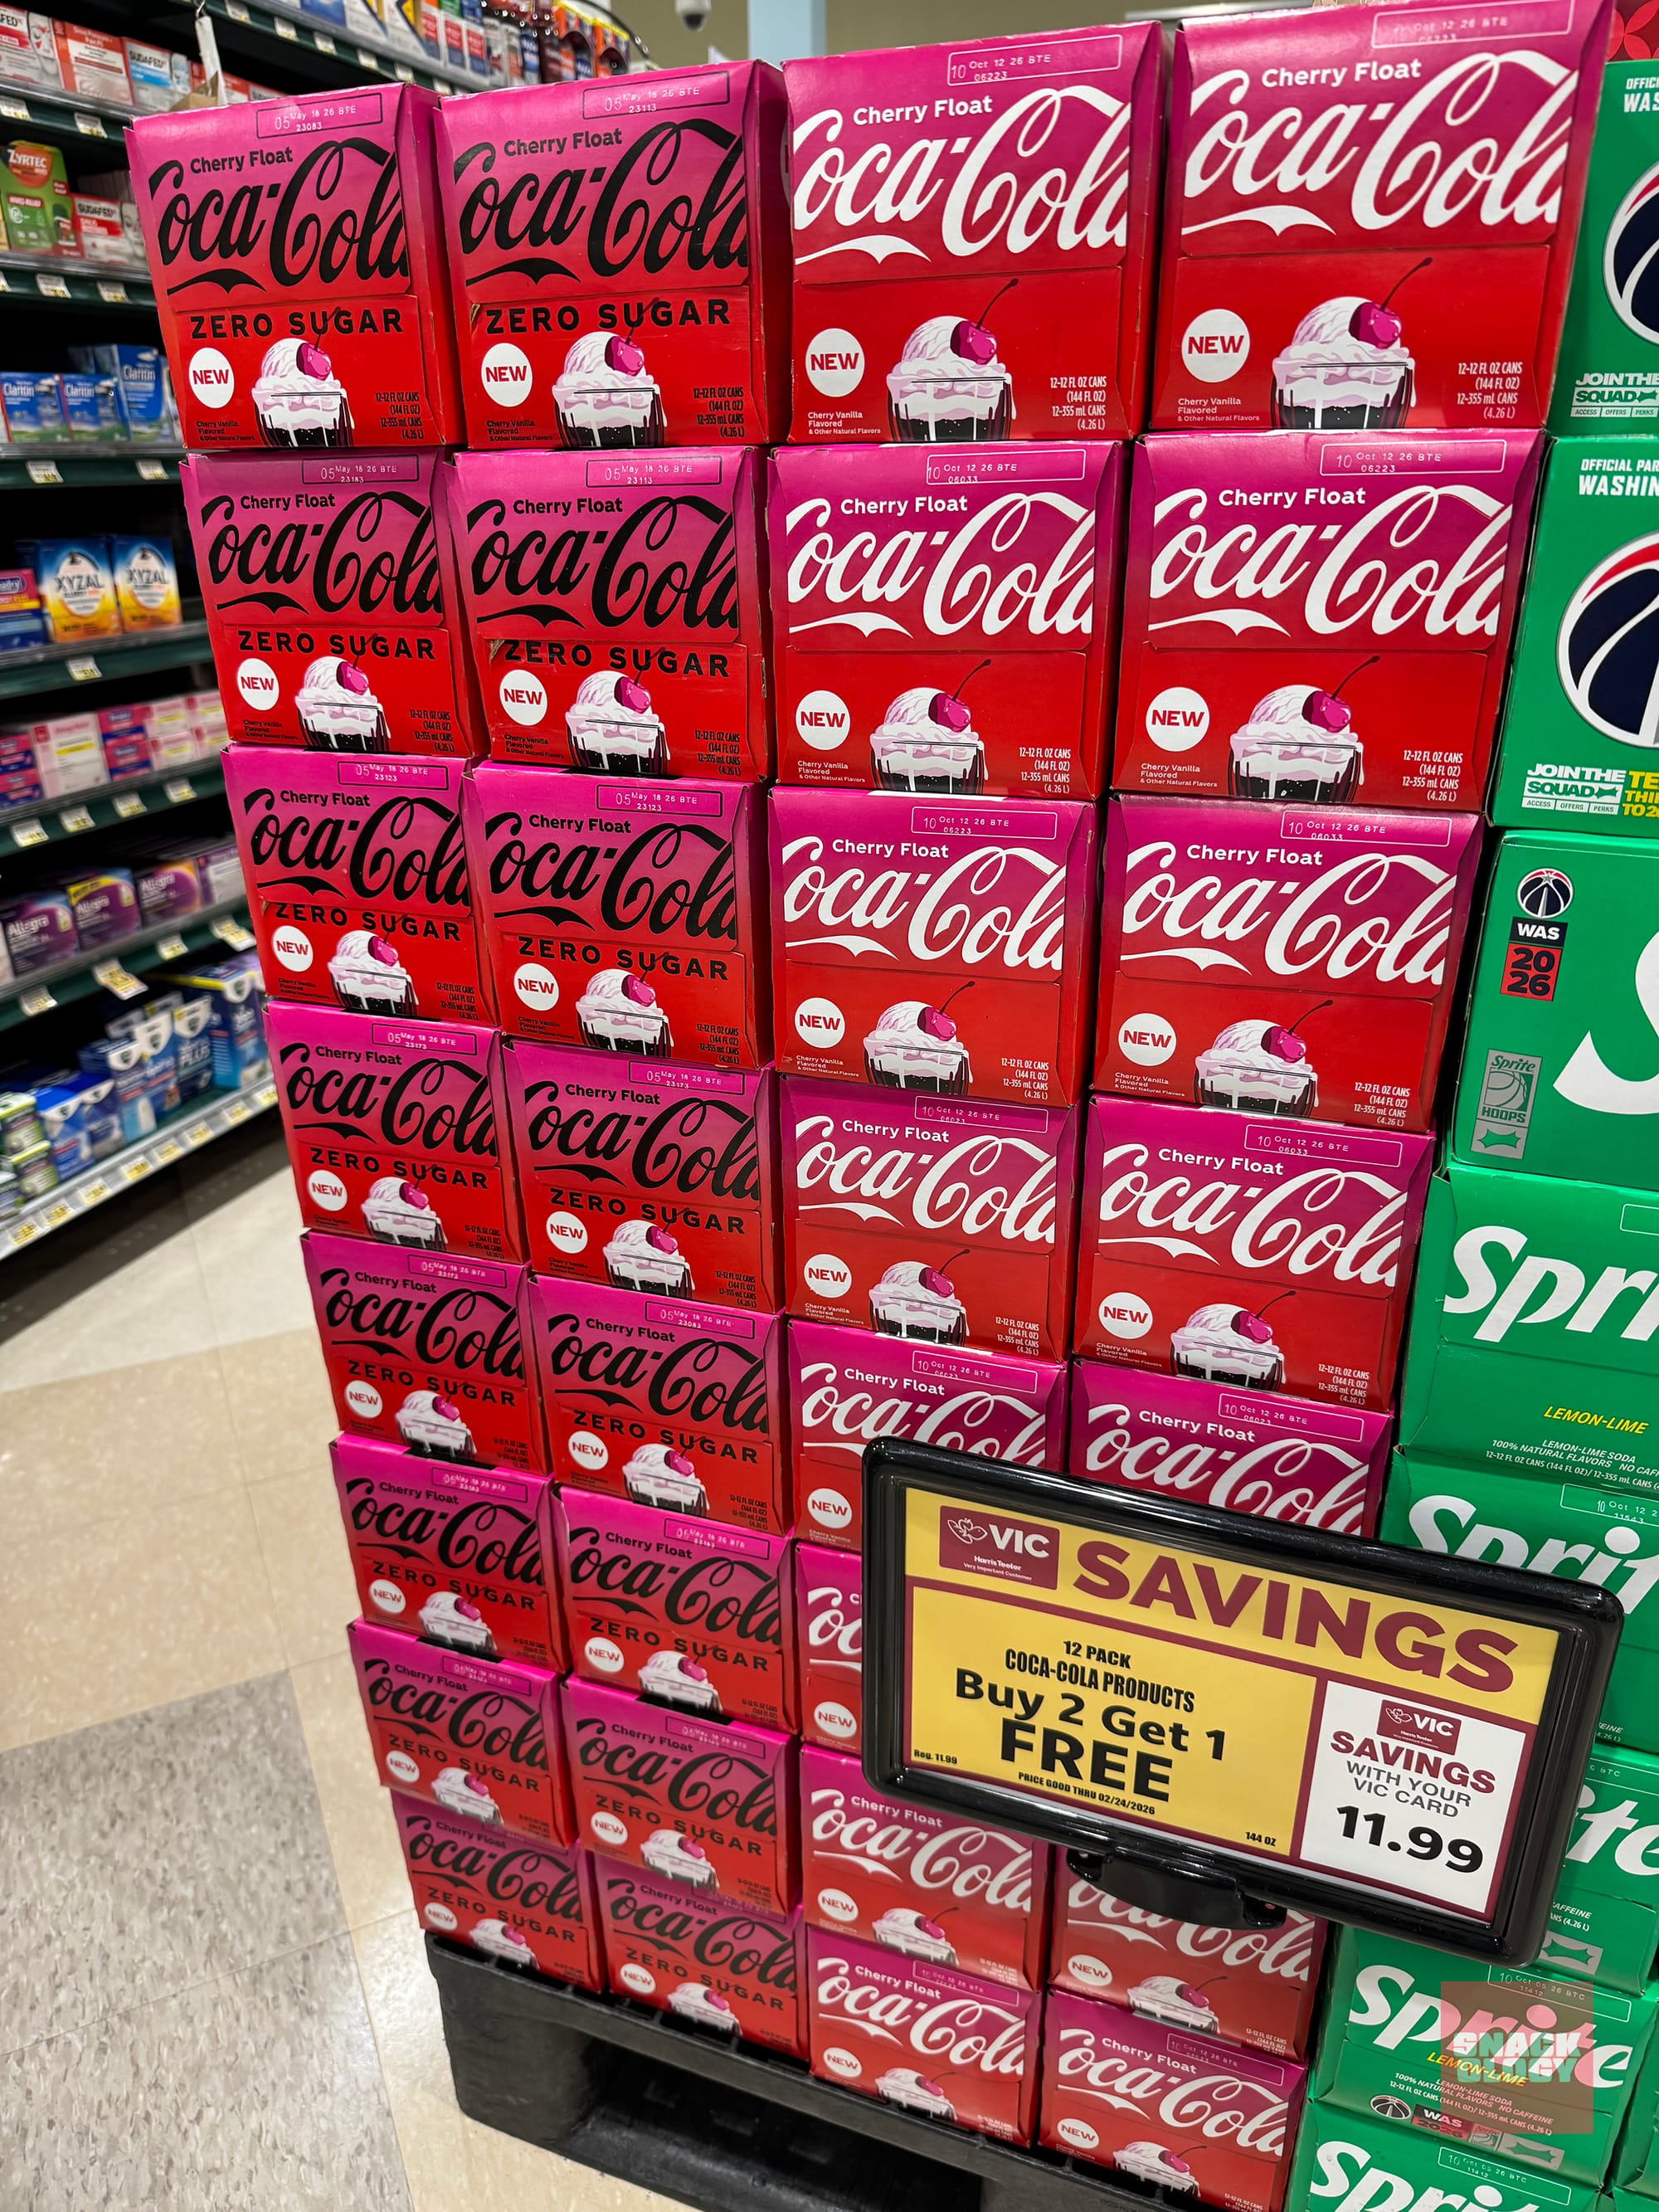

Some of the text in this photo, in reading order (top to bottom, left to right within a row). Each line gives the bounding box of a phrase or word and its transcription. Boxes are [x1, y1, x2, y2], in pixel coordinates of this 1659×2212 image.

[854, 96, 992, 125] Cherry Float
[8, 149, 47, 168] ZYRTEC
[191, 148, 293, 174] Cherry Float
[190, 309, 403, 339] ZERO SUGAR
[1188, 335, 1244, 354] NEW
[810, 353, 859, 371] NEW
[124, 366, 155, 380] Claritin
[192, 370, 229, 385] NEW
[485, 366, 527, 382] NEW
[1576, 373, 1623, 385] JOIN
[3, 384, 34, 397] Claritin
[65, 383, 94, 397] Claritin
[1050, 377, 1107, 388] 12-12 FL OZ CANS
[1067, 392, 1106, 402] (144 FL OZ)
[1575, 390, 1637, 402] SQUAD
[808, 412, 834, 420] Cherry
[1053, 406, 1106, 417] 12-355 mL CANS
[1078, 419, 1105, 430] (4.26 L)
[944, 464, 961, 472] Oct
[966, 464, 976, 472] 12
[981, 464, 994, 472] 26
[1581, 459, 1632, 471] OFFICIAL
[55, 575, 104, 591] XYZAL
[128, 570, 168, 583] XYZAL
[241, 676, 274, 690] NEW
[504, 689, 542, 705] NEW
[800, 711, 845, 728] NEW
[1151, 710, 1204, 727] NEW
[1527, 763, 1627, 782] JOIN THE
[1527, 781, 1595, 797] SQUAD
[1623, 804, 1645, 816] TO
[832, 839, 949, 859] Cherry Float
[8, 914, 49, 937] Allegra
[1516, 923, 1560, 940] WAS
[276, 940, 309, 956] NEW
[518, 937, 728, 980] ZERO SUGAR
[1511, 948, 1555, 972] 20
[518, 979, 553, 994] NEW
[1507, 971, 1551, 996] 26
[799, 1014, 840, 1030] NEW
[1123, 1030, 1172, 1048] NEW
[1491, 1055, 1535, 1072] Sprite
[1481, 1107, 1526, 1123] HOOPS
[312, 1182, 343, 1196] NEW
[808, 1267, 848, 1283] NEW
[1103, 1308, 1148, 1323] NEW
[1544, 1406, 1649, 1434] LEMON-LIME
[1492, 1440, 1518, 1450] 100%
[1520, 1444, 1564, 1459] NATURAL
[1566, 1453, 1612, 1468] FLAVORS
[1619, 1464, 1635, 1473] NO
[1542, 1440, 1636, 1464] LEMON-LIME SODA
[811, 1499, 848, 1516] NEW
[989, 1524, 1049, 1558] VIC
[974, 1556, 1021, 1571] Harris Teeter
[977, 1566, 1004, 1575] Important
[1005, 1570, 1032, 1581] Customer
[1073, 1541, 1518, 1693] SAVINGS
[1063, 1641, 1131, 1669] 12 PACK
[1005, 1649, 1194, 1713] COCA-COLA PRODUCTS
[956, 1668, 1225, 1761] Buy 2 Get 1
[1413, 1713, 1454, 1737] VIC
[914, 1749, 957, 1764] Reg. 11.99
[1000, 1717, 1173, 1802] FREE
[1331, 1731, 1496, 1794] SAVINGS
[1347, 1761, 1472, 1807] WITH YOUR
[1019, 1772, 1155, 1815] PRICE GOOD THRU 02/24/2026
[1354, 1778, 1458, 1817] VIC CARD
[1245, 1831, 1277, 1846] 144 OZ
[1336, 1805, 1483, 1873] 11.99
[821, 1897, 854, 1912] NEW
[1349, 1964, 1633, 2088] Sprite
[1102, 2037, 1197, 2074] Cherry Float
[1427, 2052, 1529, 2087] LEMON-LIME
[1423, 2109, 1462, 2127] WAS
